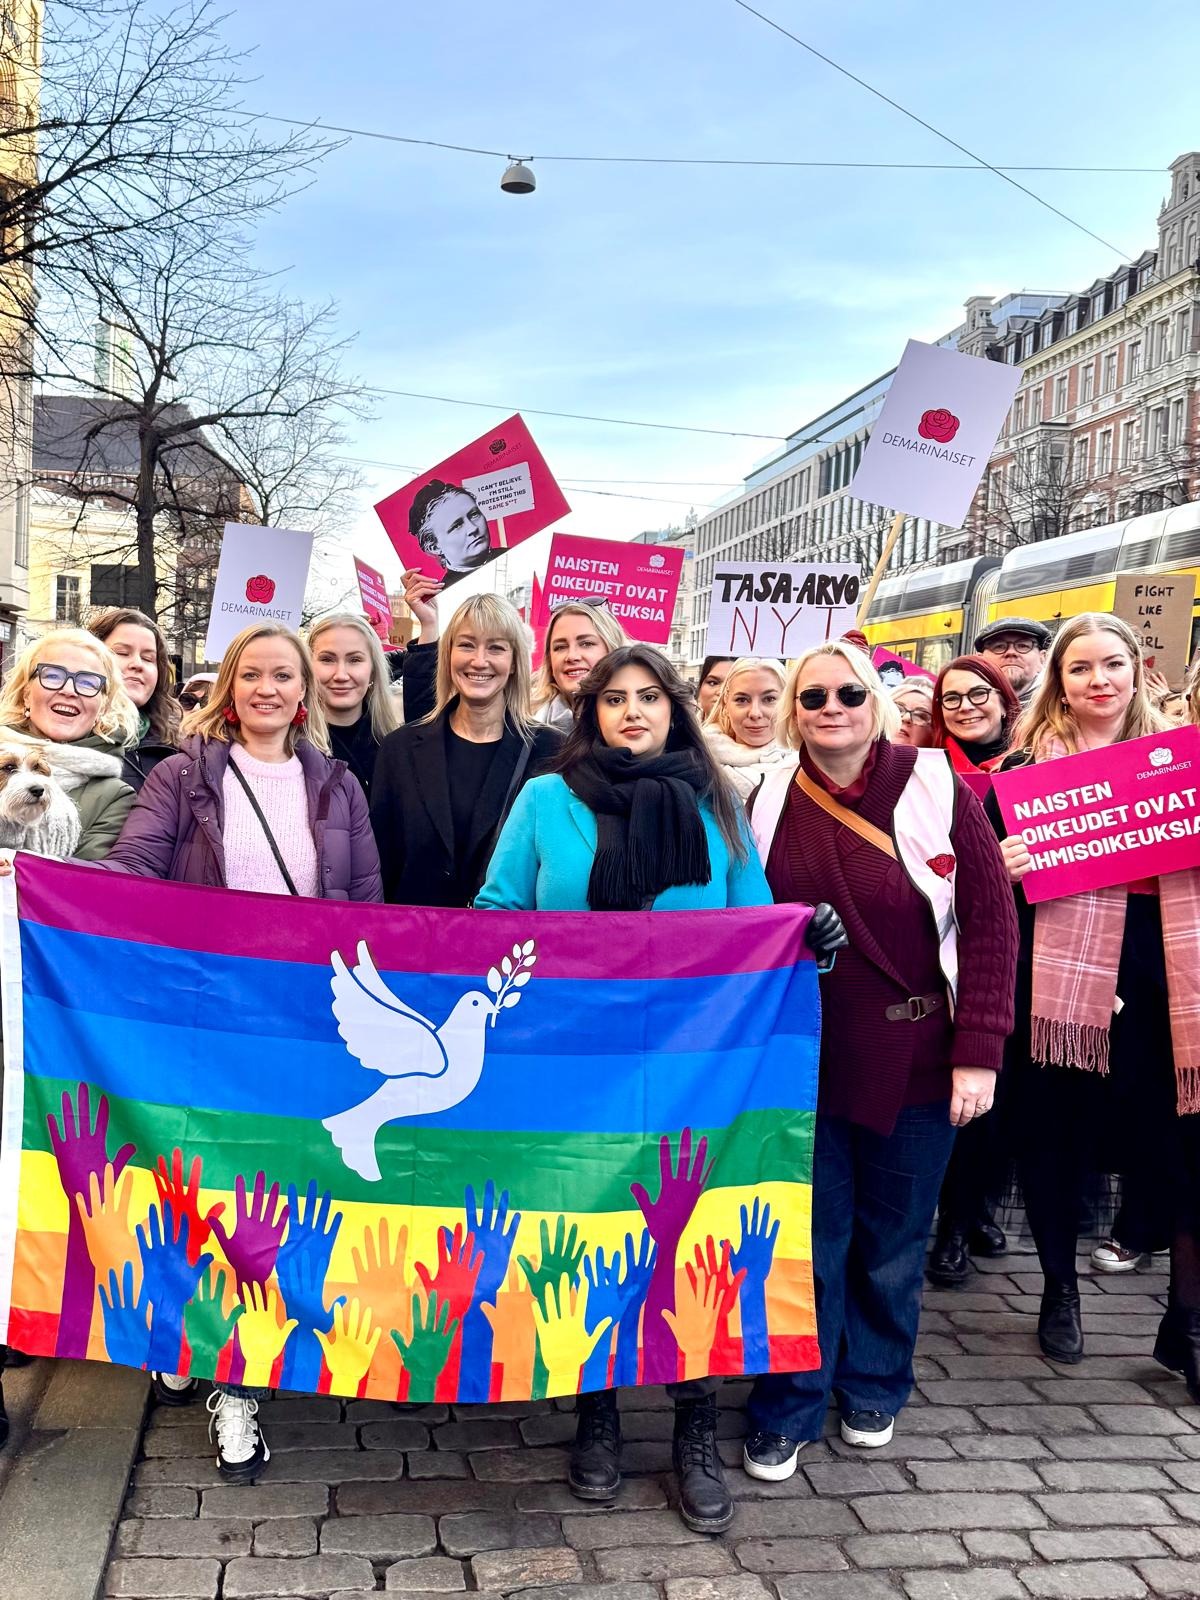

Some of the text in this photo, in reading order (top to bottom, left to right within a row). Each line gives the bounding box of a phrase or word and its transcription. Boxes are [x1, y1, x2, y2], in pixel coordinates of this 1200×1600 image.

[882, 432, 976, 467] DEMARINAISET
[498, 486, 513, 494] STILL
[554, 555, 620, 576] NAISTEN
[551, 575, 669, 603] OIKEUDET OVAT
[715, 571, 860, 606] TASA-ARVO
[1135, 585, 1174, 597] FIGHT
[221, 602, 292, 621] DEMARINAISET
[1138, 605, 1162, 615] LIKE
[730, 606, 846, 654] NYT
[1143, 620, 1151, 628] A
[1136, 761, 1192, 780] DEMARINAISET
[1013, 781, 1114, 821] NAISTEN
[1021, 787, 1198, 846] OIKEUDET OVAT
